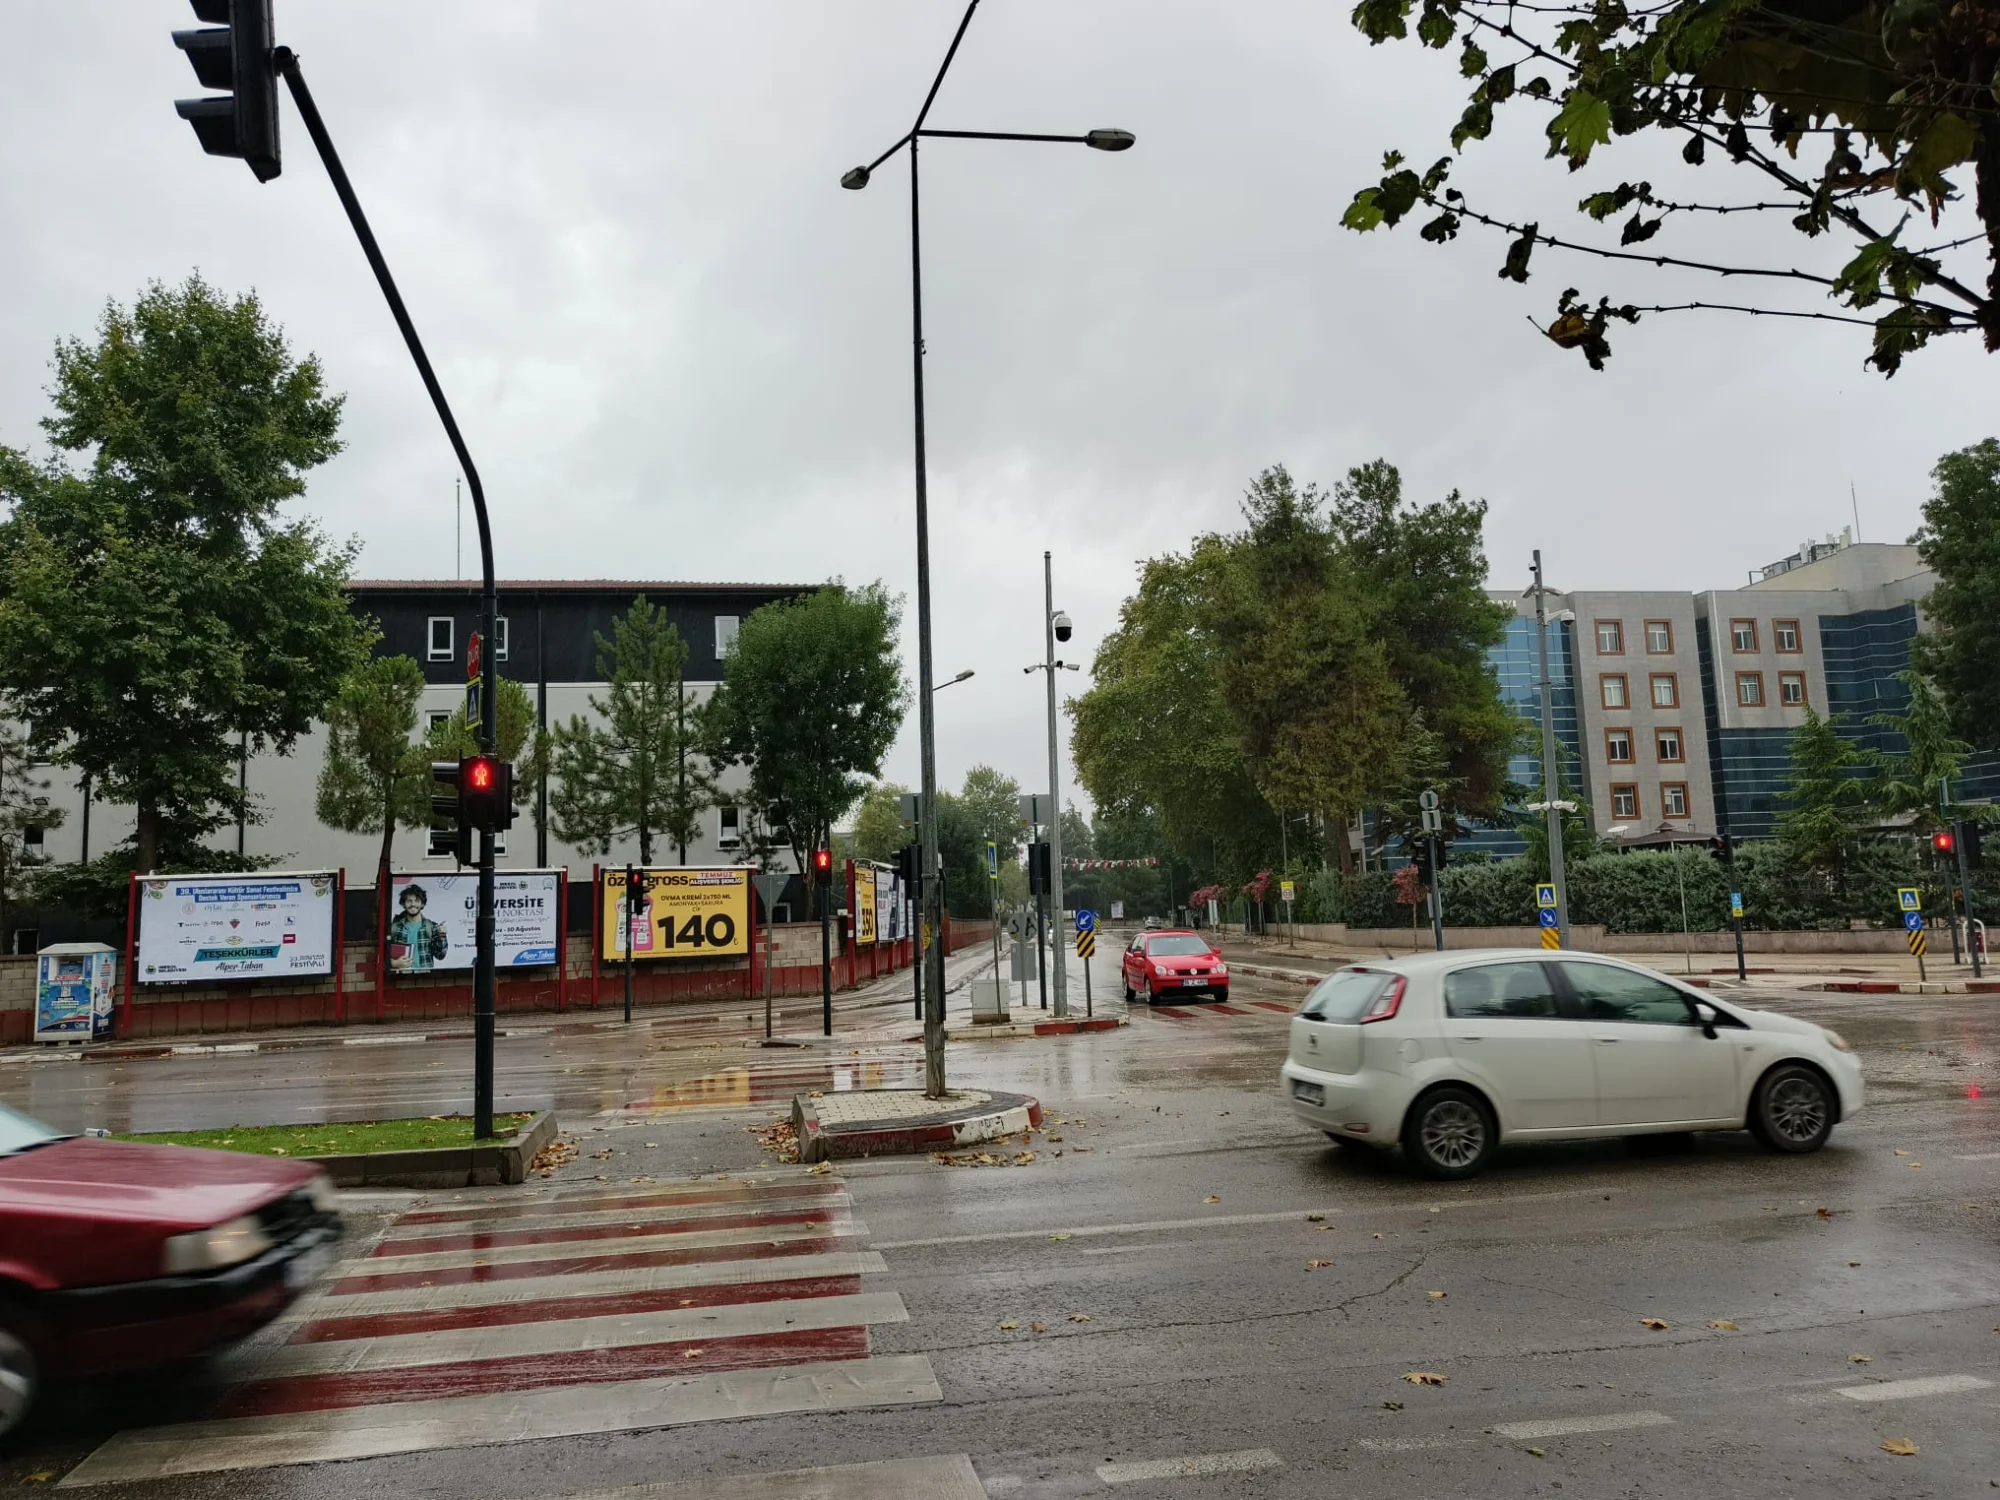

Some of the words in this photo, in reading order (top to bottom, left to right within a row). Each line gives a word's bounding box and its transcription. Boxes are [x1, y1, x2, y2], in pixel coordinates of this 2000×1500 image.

[467, 644, 480, 666] DUR
[657, 913, 735, 949] 140
[203, 947, 273, 959] TEŞEKKÜRLER
[215, 961, 238, 973] Alper
[239, 960, 263, 969] Taban
